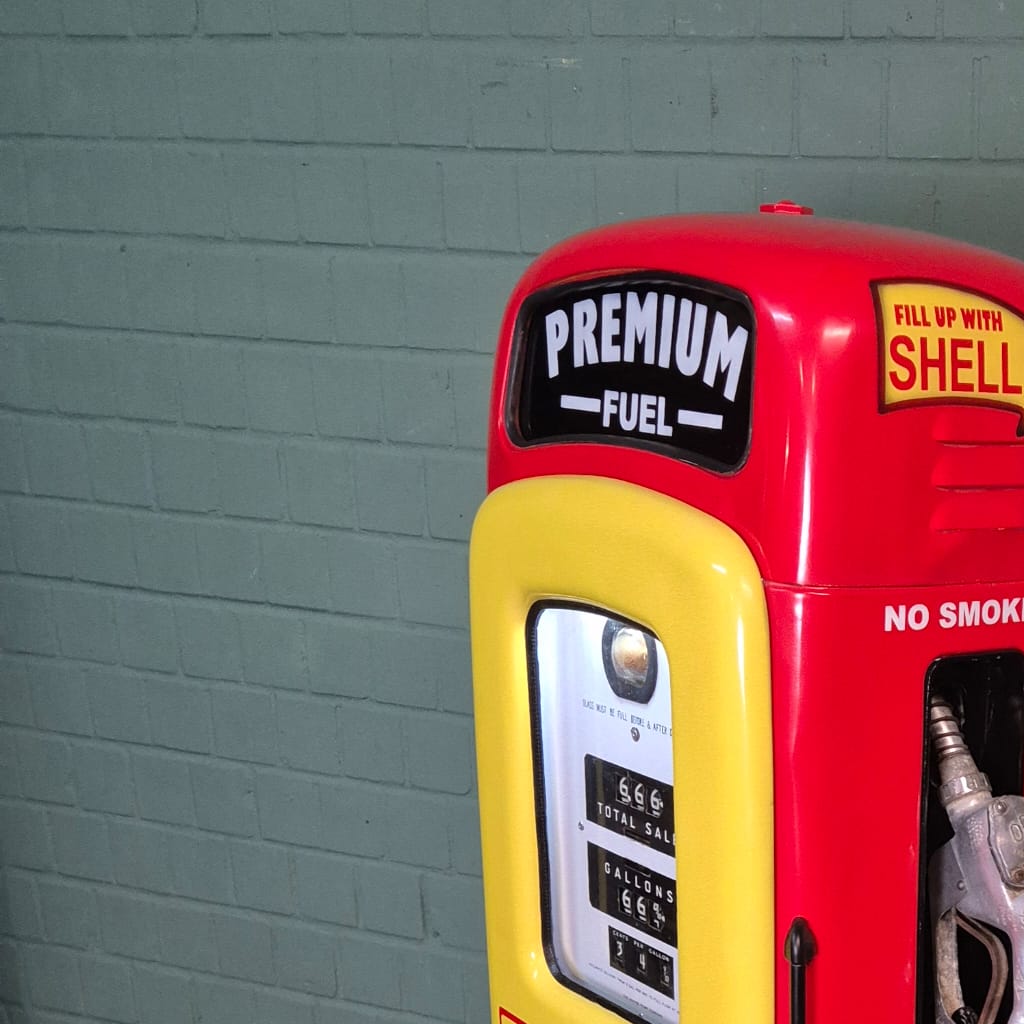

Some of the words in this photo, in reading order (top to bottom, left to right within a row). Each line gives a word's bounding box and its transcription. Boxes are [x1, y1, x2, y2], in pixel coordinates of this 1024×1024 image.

[893, 303, 931, 327] FILL
[934, 306, 957, 328] UP
[960, 307, 1003, 332] WITH
[545, 291, 749, 402] PREMIUM
[888, 335, 1023, 395] SHELL
[602, 389, 673, 437] FUEL
[884, 604, 930, 632] NO
[653, 723, 667, 735] AFTER
[597, 801, 636, 829] TOTAL
[604, 862, 674, 904] GALLONS
